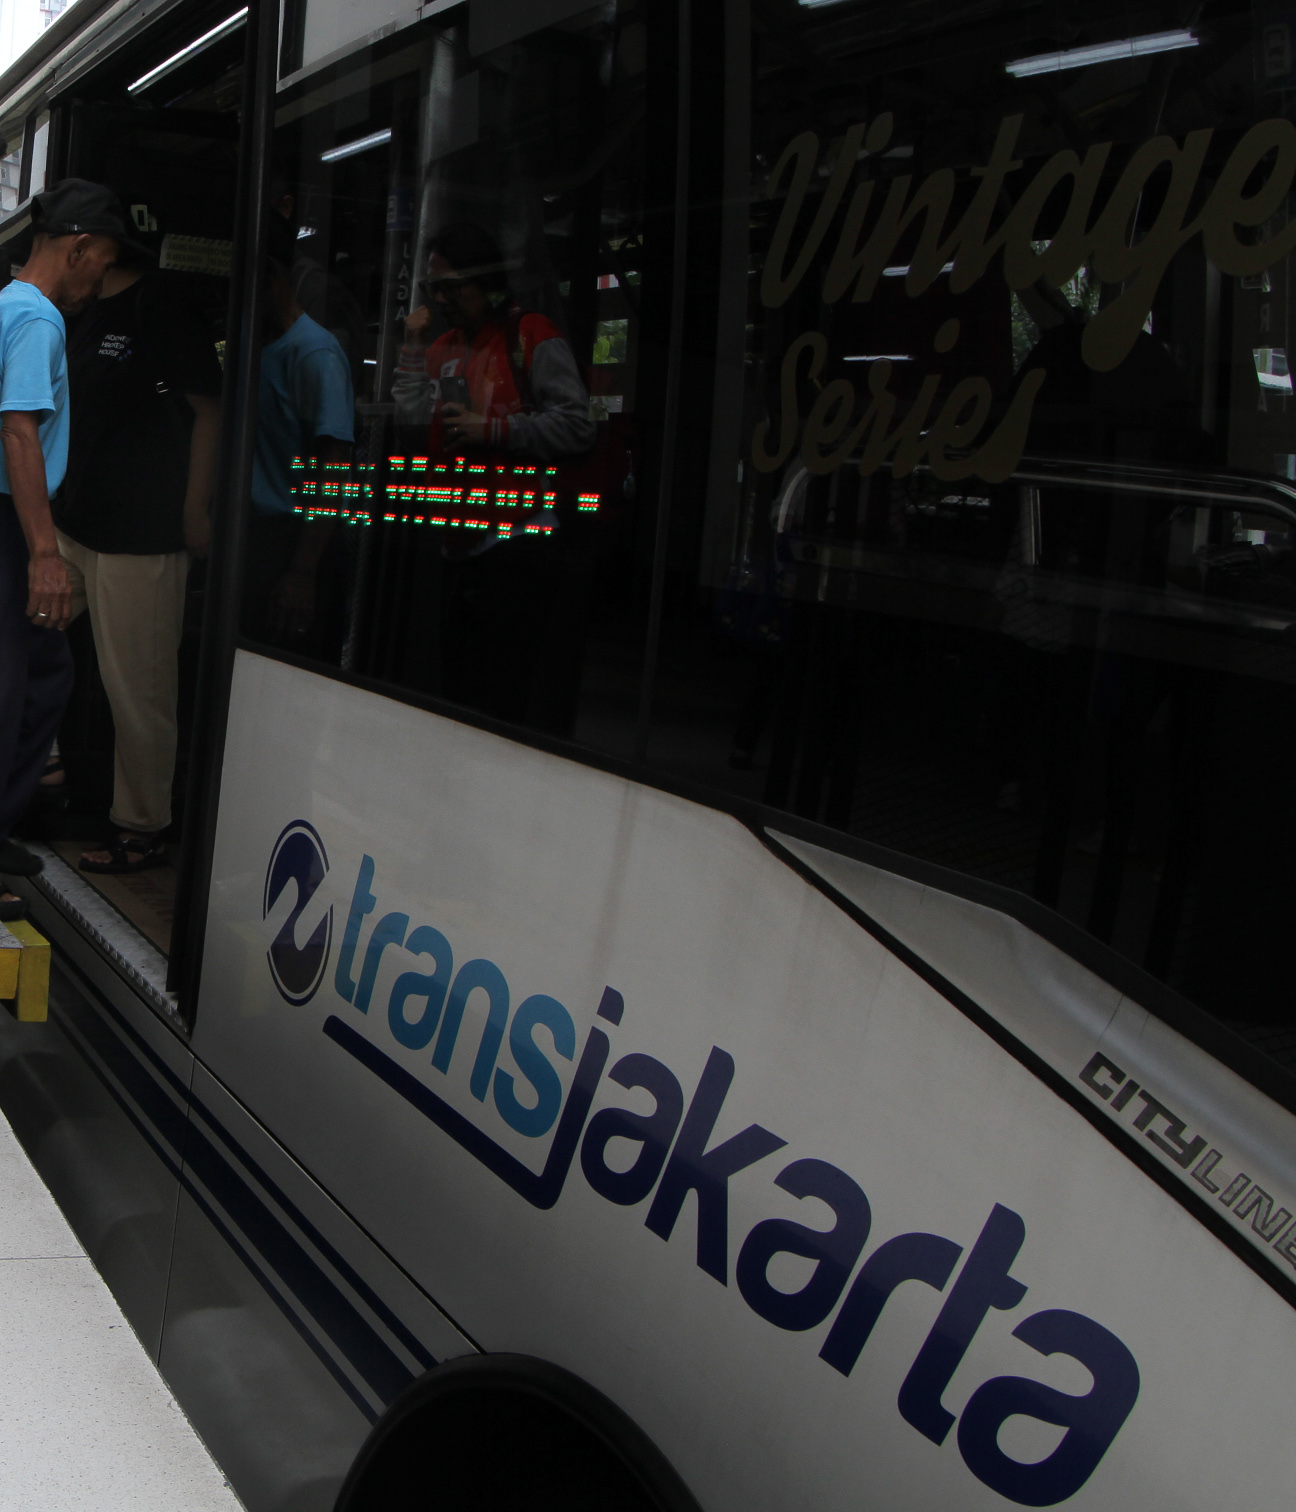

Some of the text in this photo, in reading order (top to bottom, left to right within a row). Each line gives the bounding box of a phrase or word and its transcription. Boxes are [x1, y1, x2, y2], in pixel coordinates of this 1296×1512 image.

[760, 111, 1296, 372] Vintage
[751, 316, 1047, 484] Series
[323, 853, 1142, 1508] transjakarta
